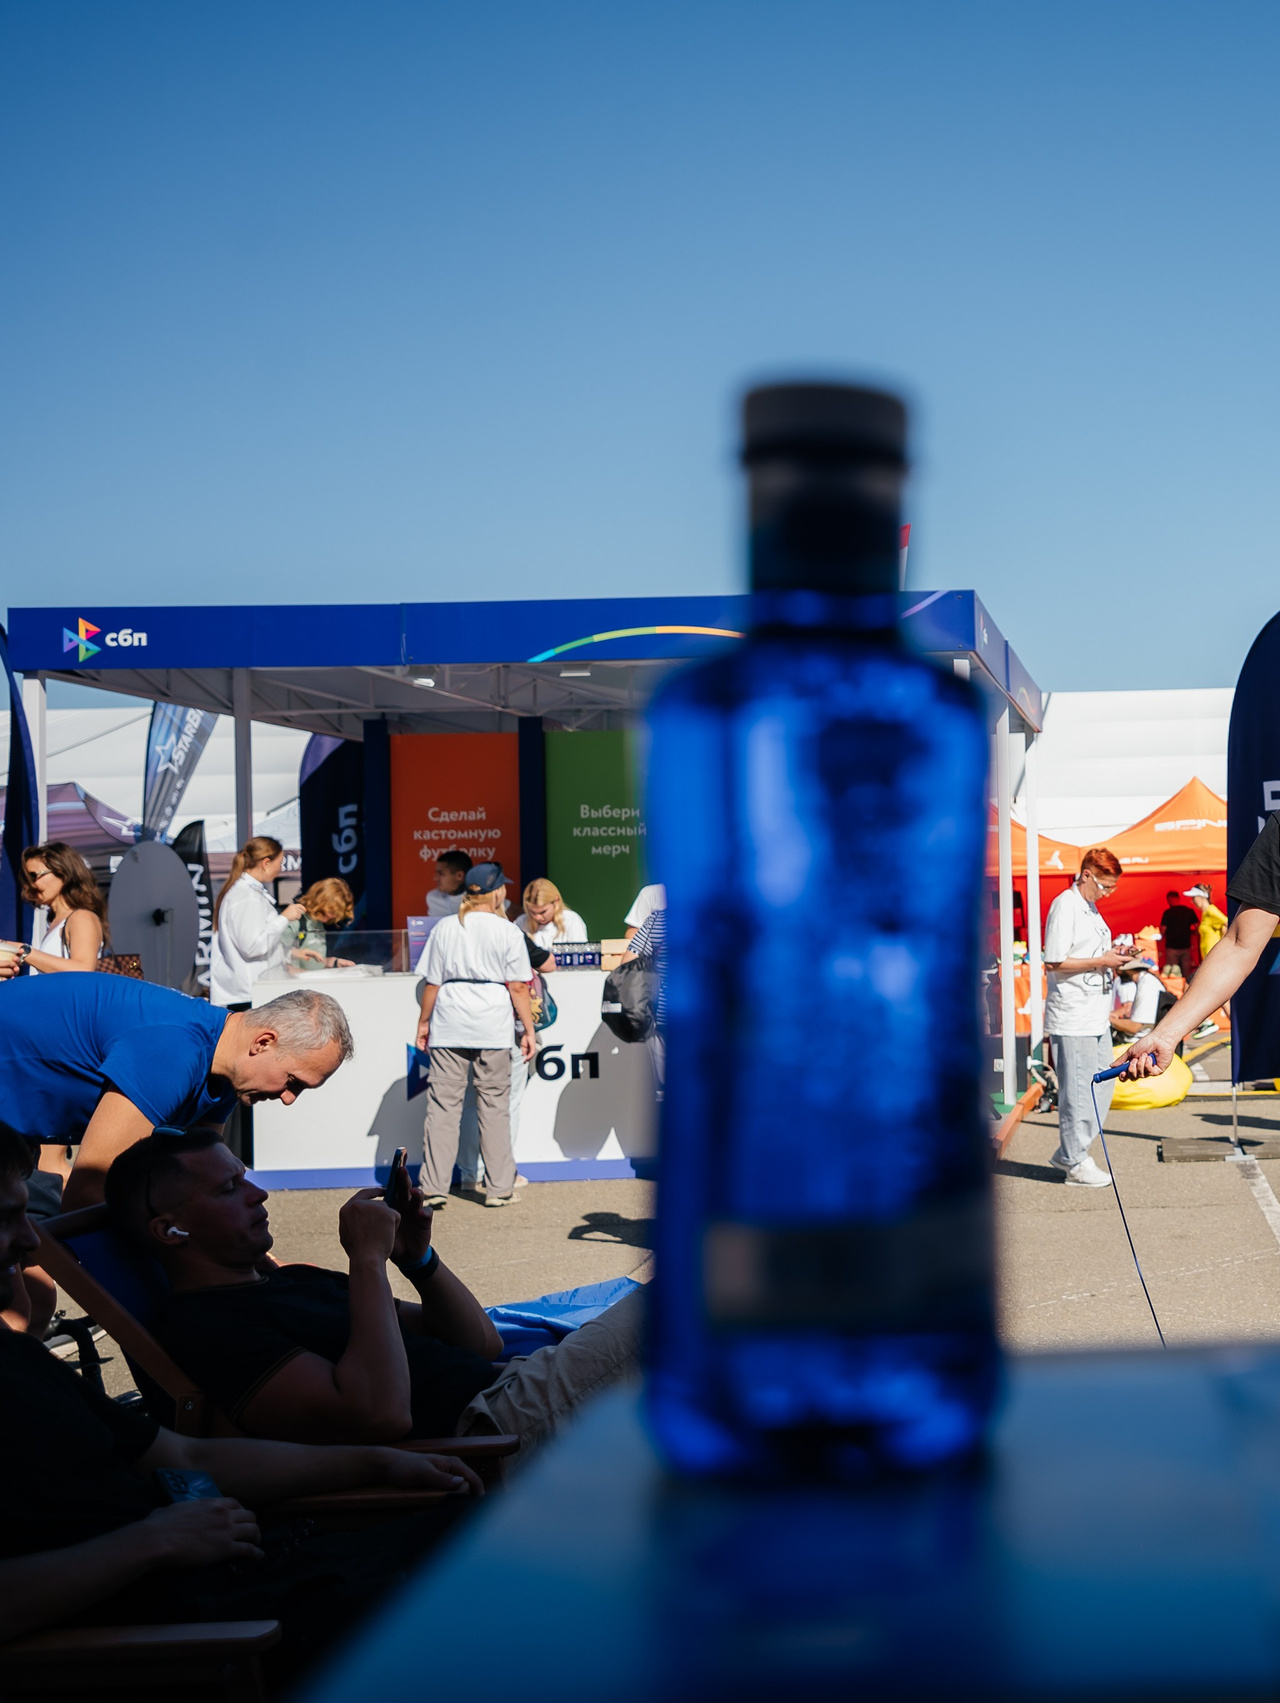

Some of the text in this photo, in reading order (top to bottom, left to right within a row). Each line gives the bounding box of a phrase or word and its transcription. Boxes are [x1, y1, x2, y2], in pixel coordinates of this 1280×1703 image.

[104, 628, 148, 647] сбп
[427, 806, 487, 823] Сделай
[580, 803, 641, 821] Выбери
[413, 828, 502, 843] кастомную
[573, 822, 647, 837] классный
[332, 804, 358, 874] сбп
[591, 844, 630, 858] мерч
[528, 1043, 600, 1081] бп
